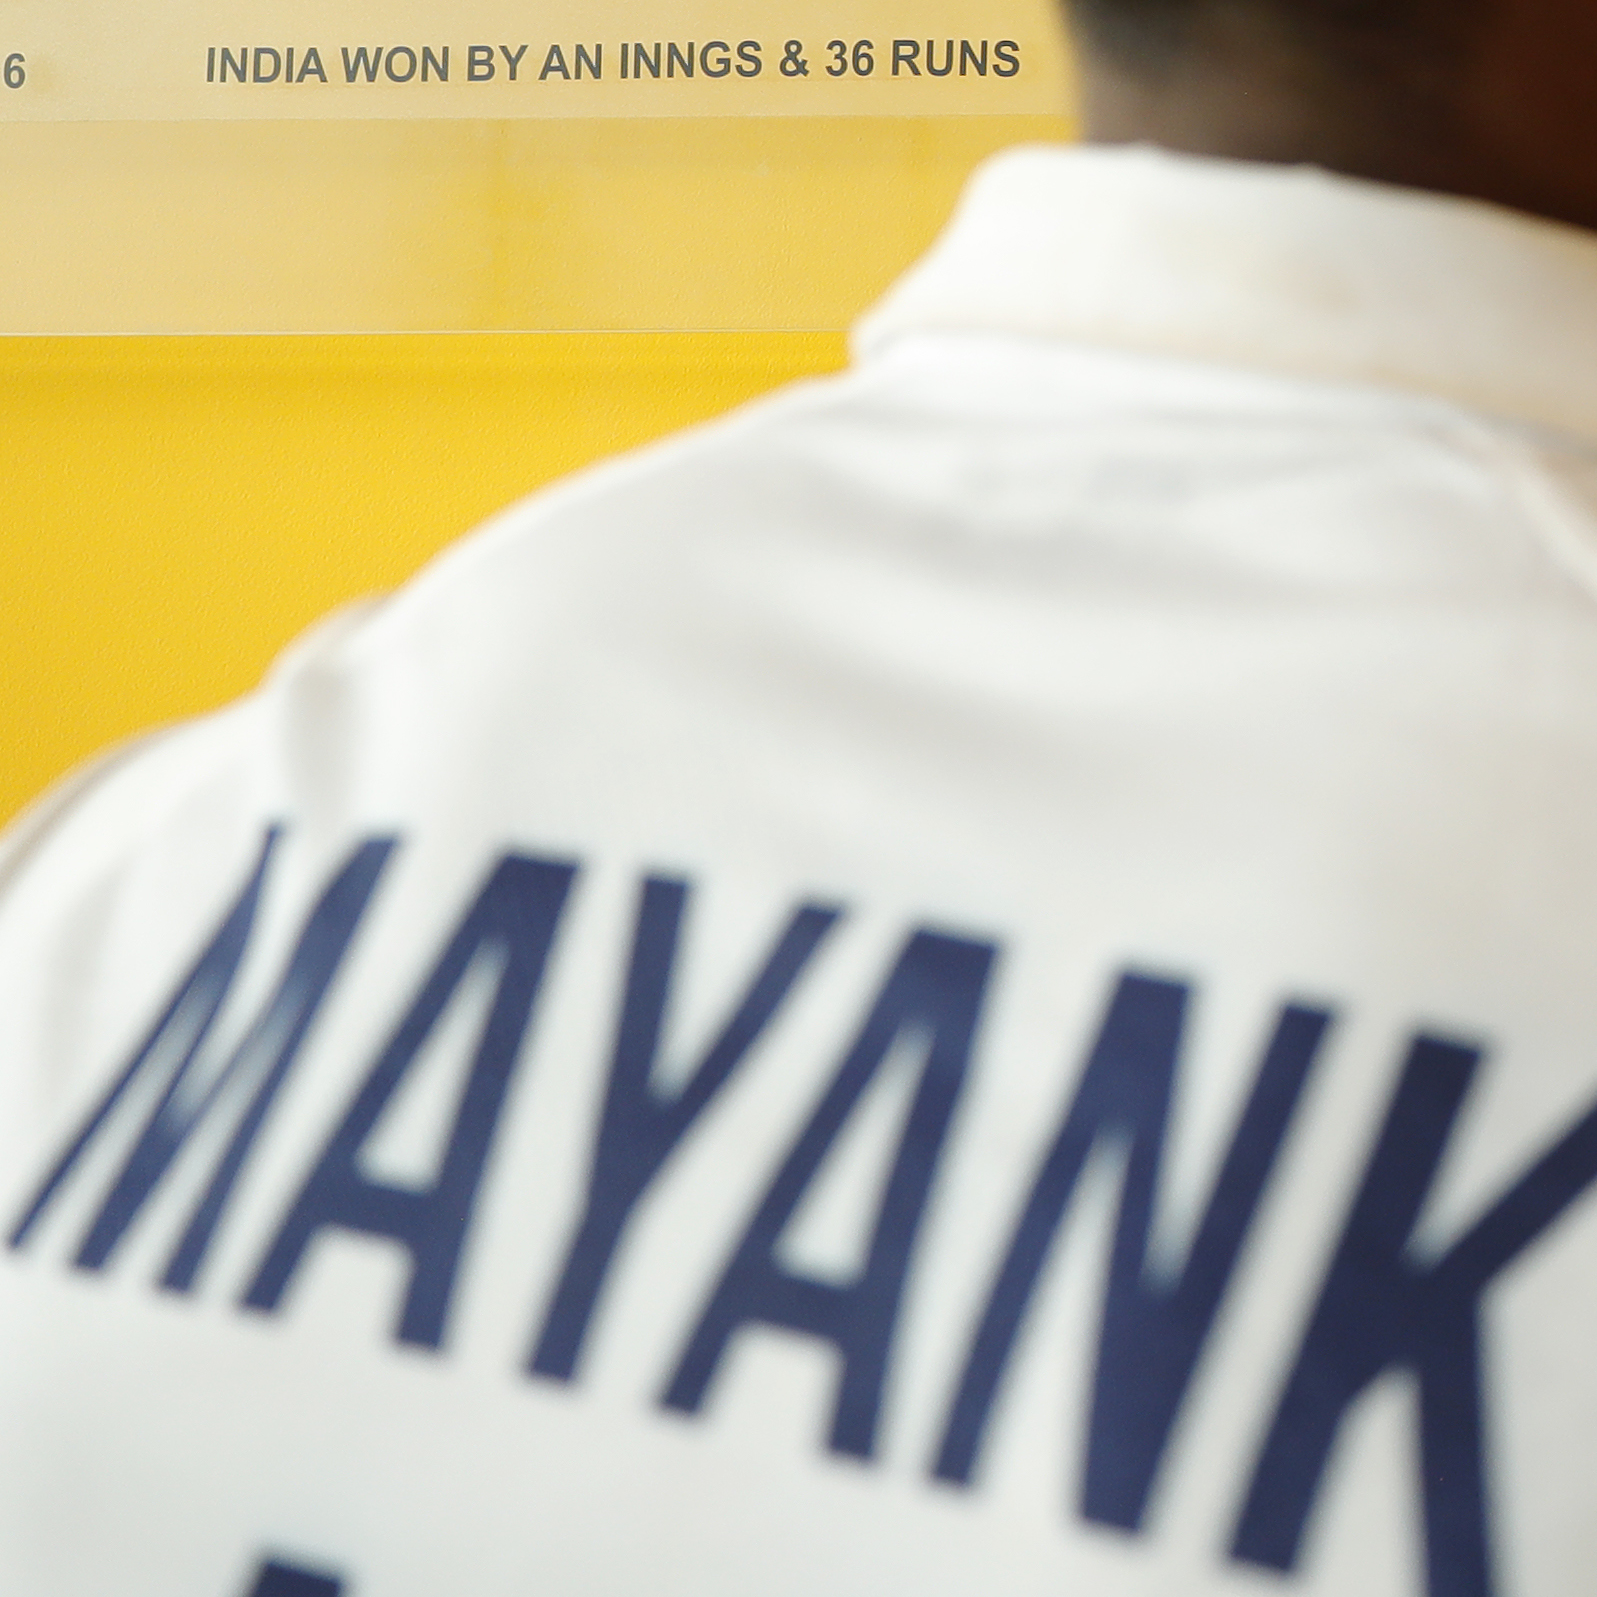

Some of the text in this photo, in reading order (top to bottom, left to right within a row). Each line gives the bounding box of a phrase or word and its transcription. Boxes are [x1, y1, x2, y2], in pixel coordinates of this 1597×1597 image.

[206, 39, 1021, 84] INDIA WON BY AN INNGS & 36 RUNS
